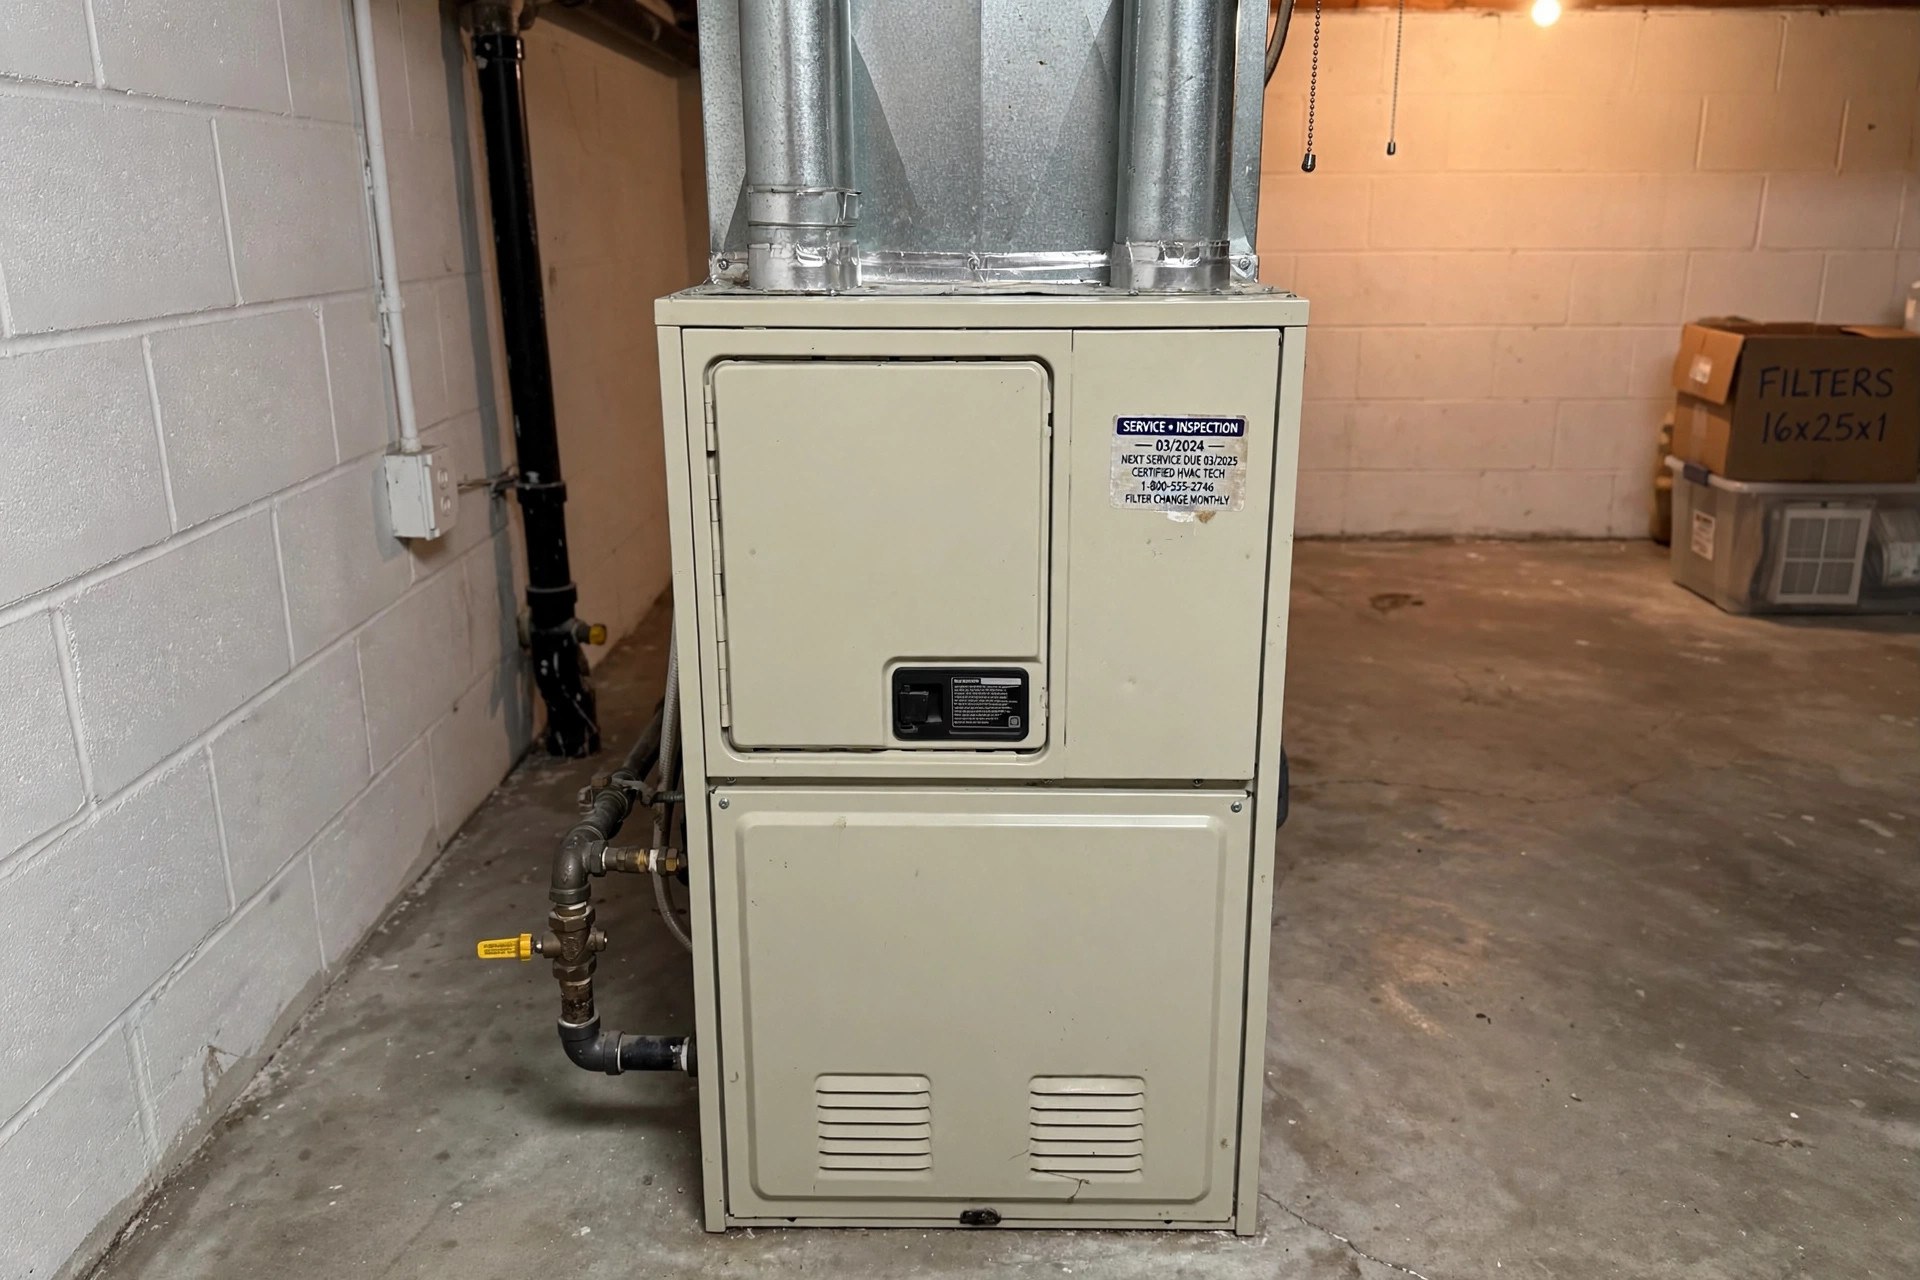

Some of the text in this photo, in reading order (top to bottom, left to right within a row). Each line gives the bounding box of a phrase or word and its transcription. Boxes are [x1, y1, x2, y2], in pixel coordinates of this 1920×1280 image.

[1759, 366, 1893, 399] FILTERS
[1123, 420, 1239, 434] SERVICE INSPECTION
[1762, 411, 1887, 443] 16x25x1
[1155, 439, 1205, 452] 03/2024
[1121, 454, 1238, 466] NEXT SERVICE DUE 03/2025
[1131, 467, 1225, 479] CERTIFIED HVAC TECH
[1125, 493, 1230, 506] FILTER CHANGE MONTHLY
